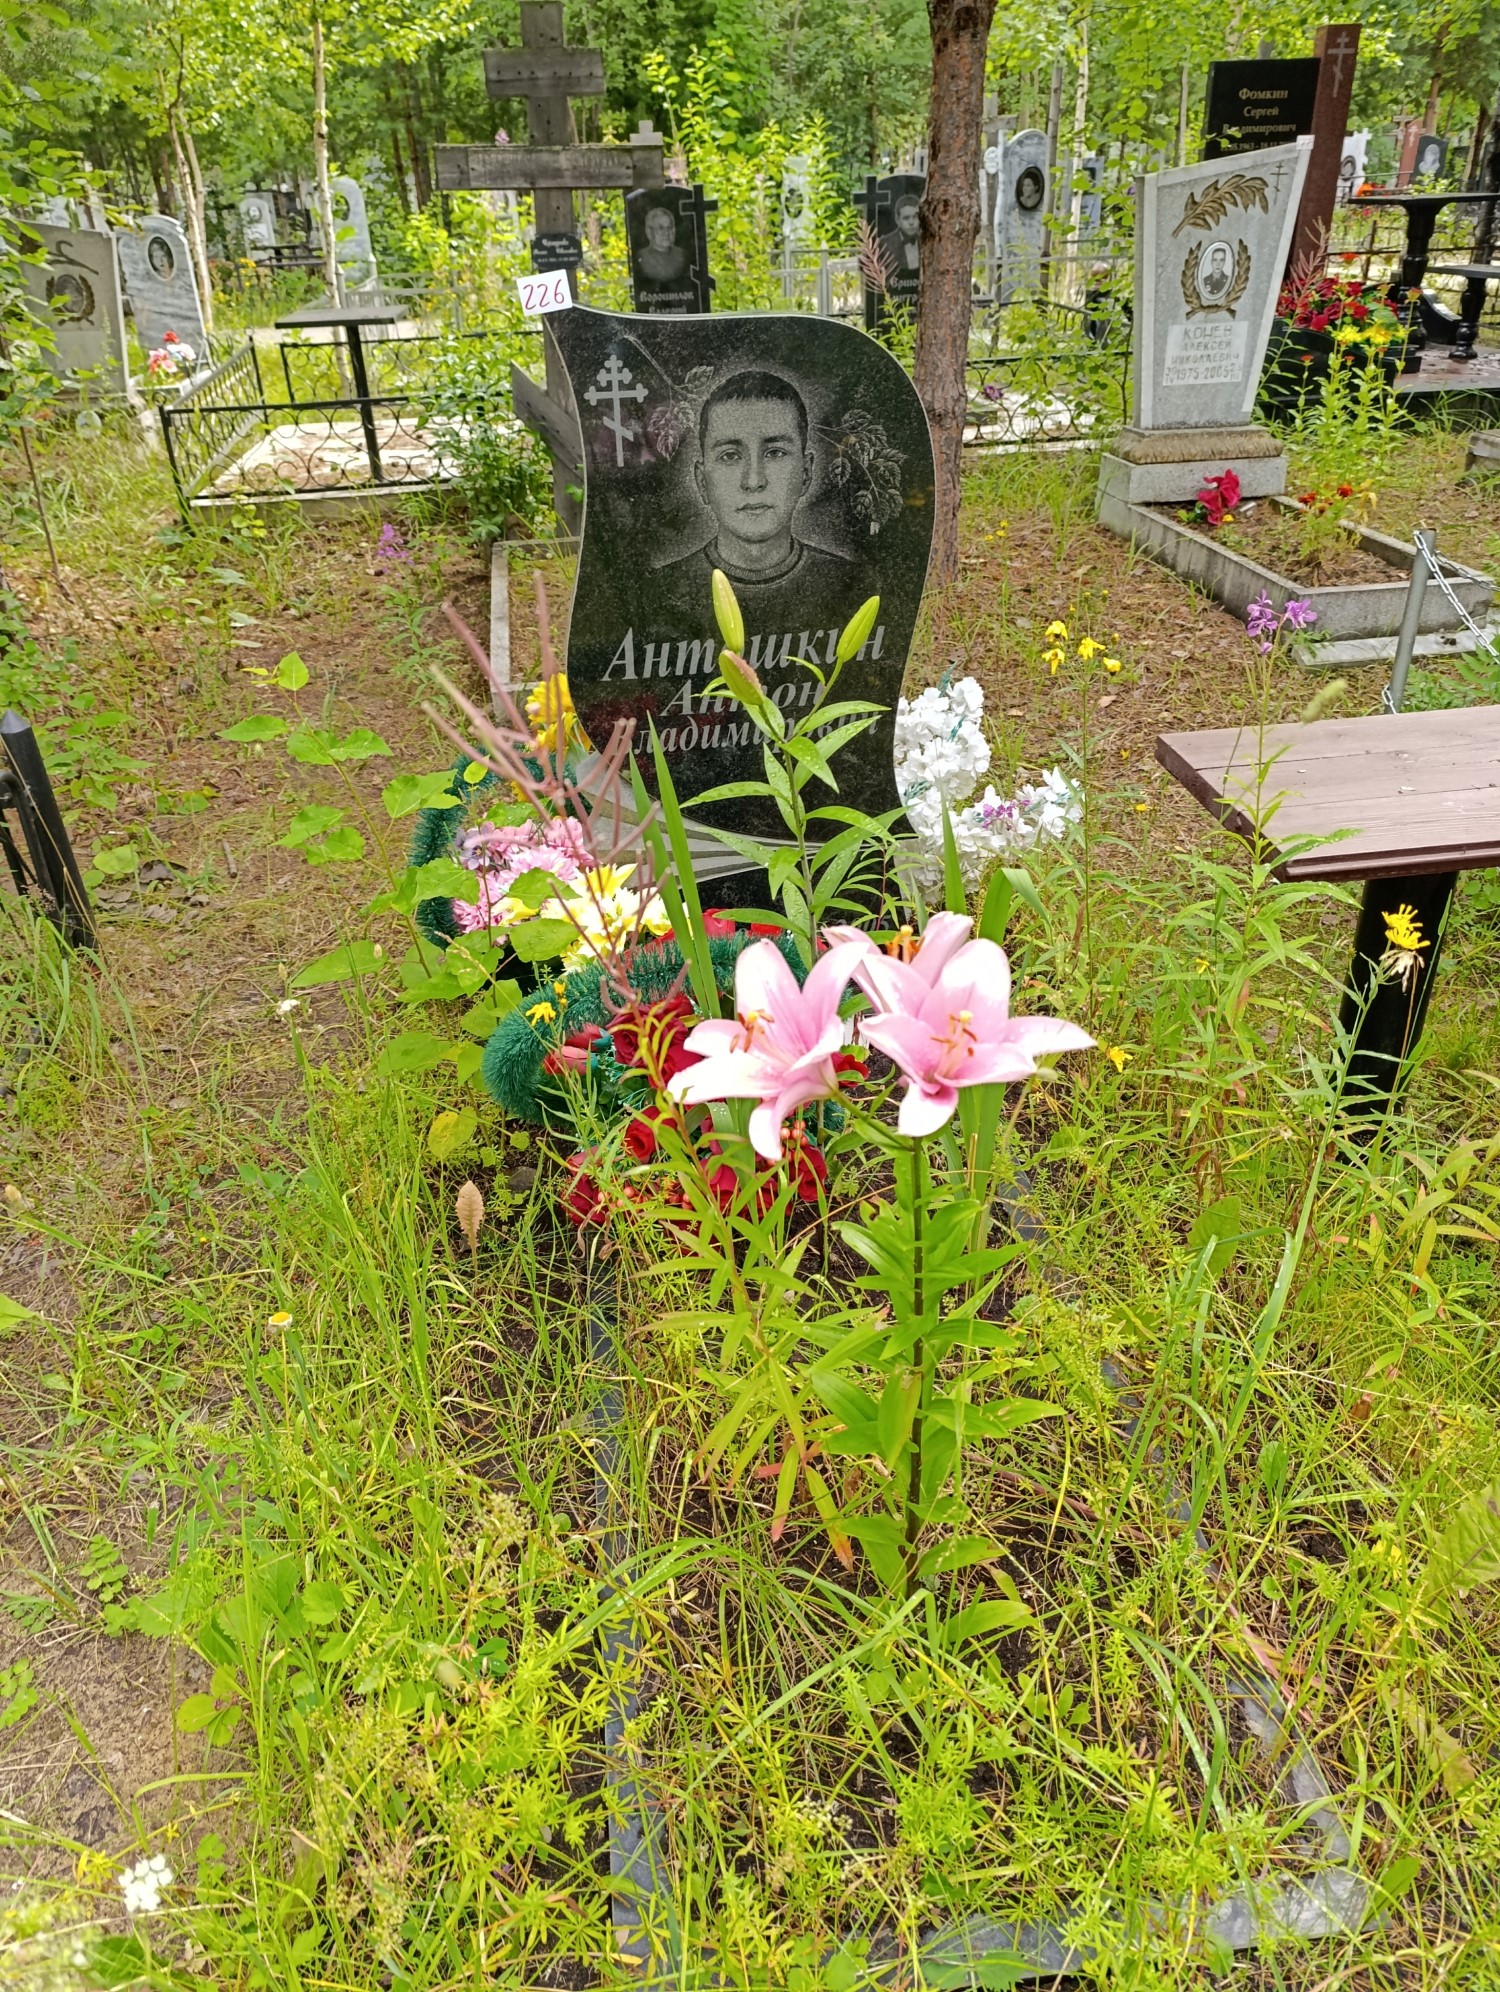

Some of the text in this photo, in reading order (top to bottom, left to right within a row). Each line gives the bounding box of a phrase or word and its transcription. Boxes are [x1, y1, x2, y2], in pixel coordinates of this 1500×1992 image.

[1239, 88, 1288, 99] Фомкин
[1243, 106, 1279, 119] Сергей
[1222, 124, 1296, 136] Вдимирович
[523, 279, 565, 310] 226
[600, 626, 886, 682] Антшкн
